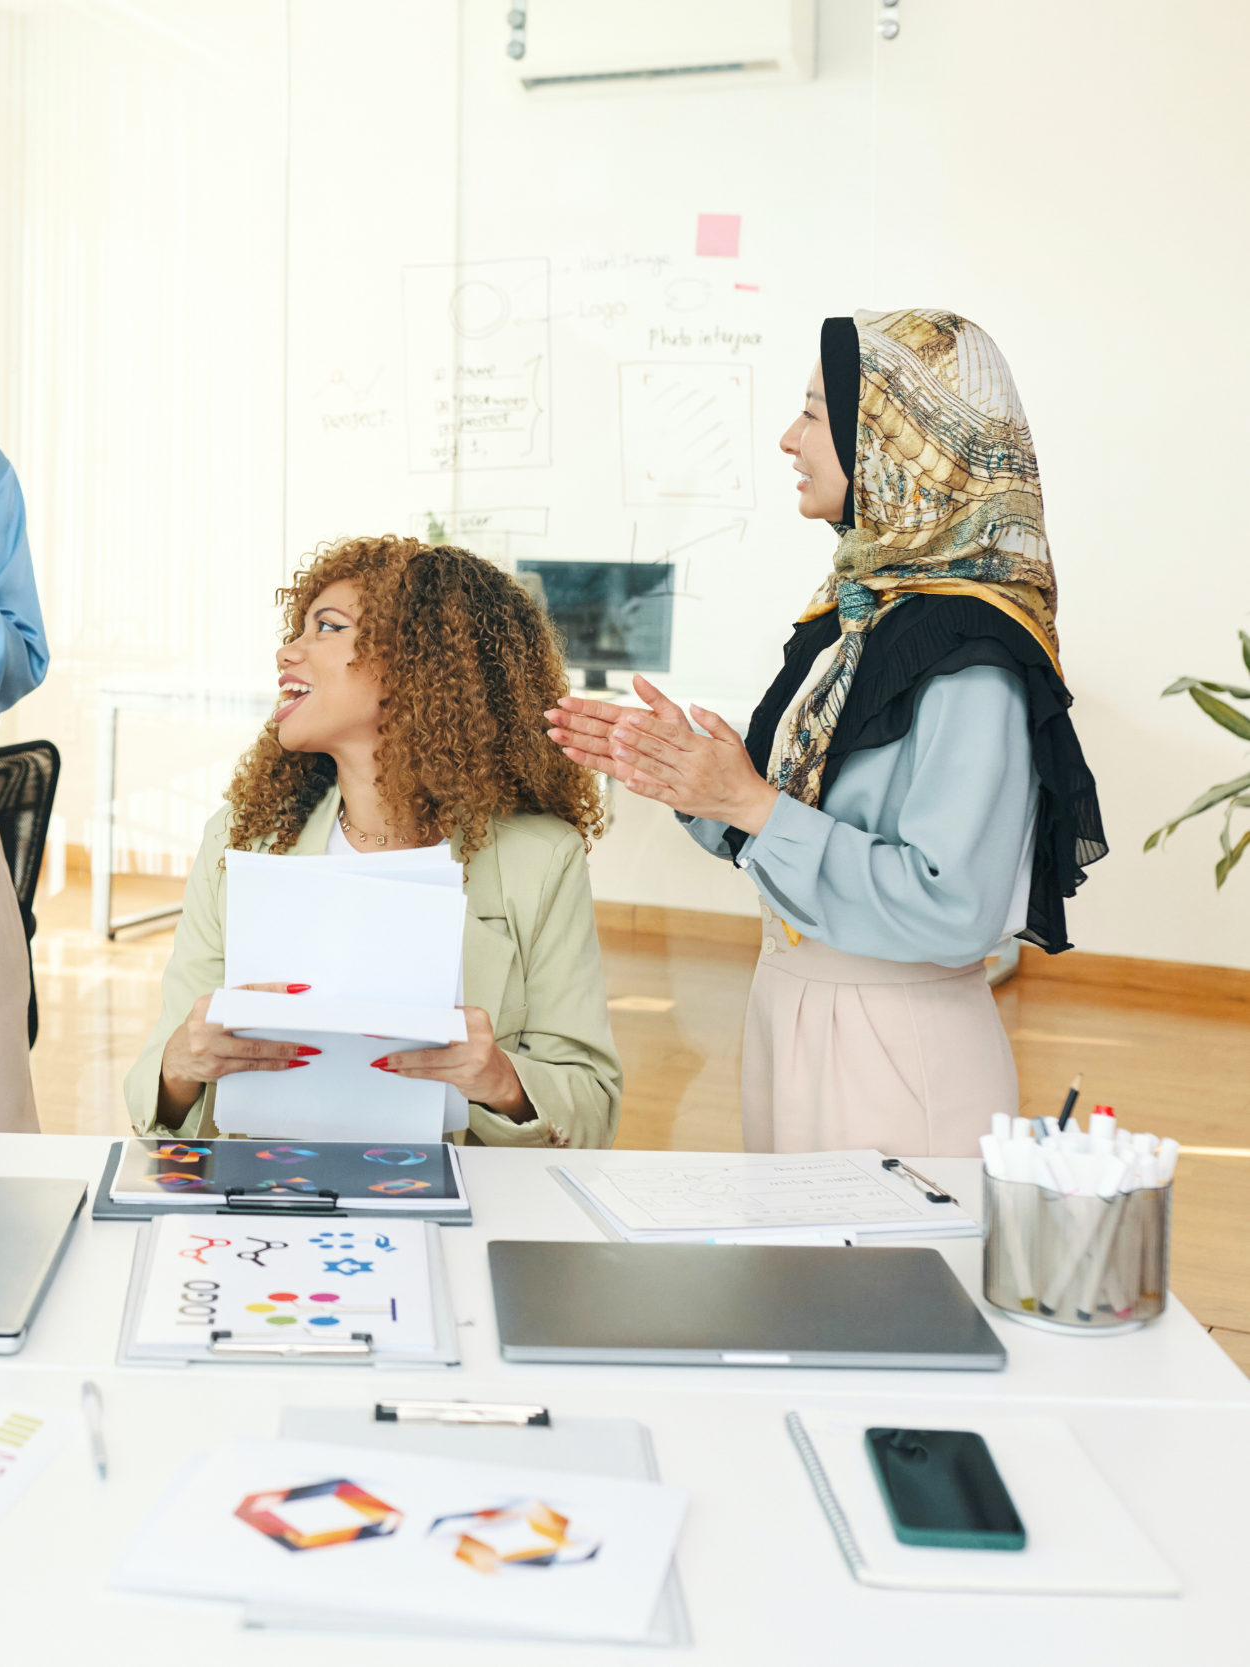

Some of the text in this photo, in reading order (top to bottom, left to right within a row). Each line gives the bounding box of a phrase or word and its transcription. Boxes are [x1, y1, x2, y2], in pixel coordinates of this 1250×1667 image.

[577, 299, 628, 330] Logo
[648, 325, 693, 353] Photo
[176, 1279, 221, 1326] LOGO
